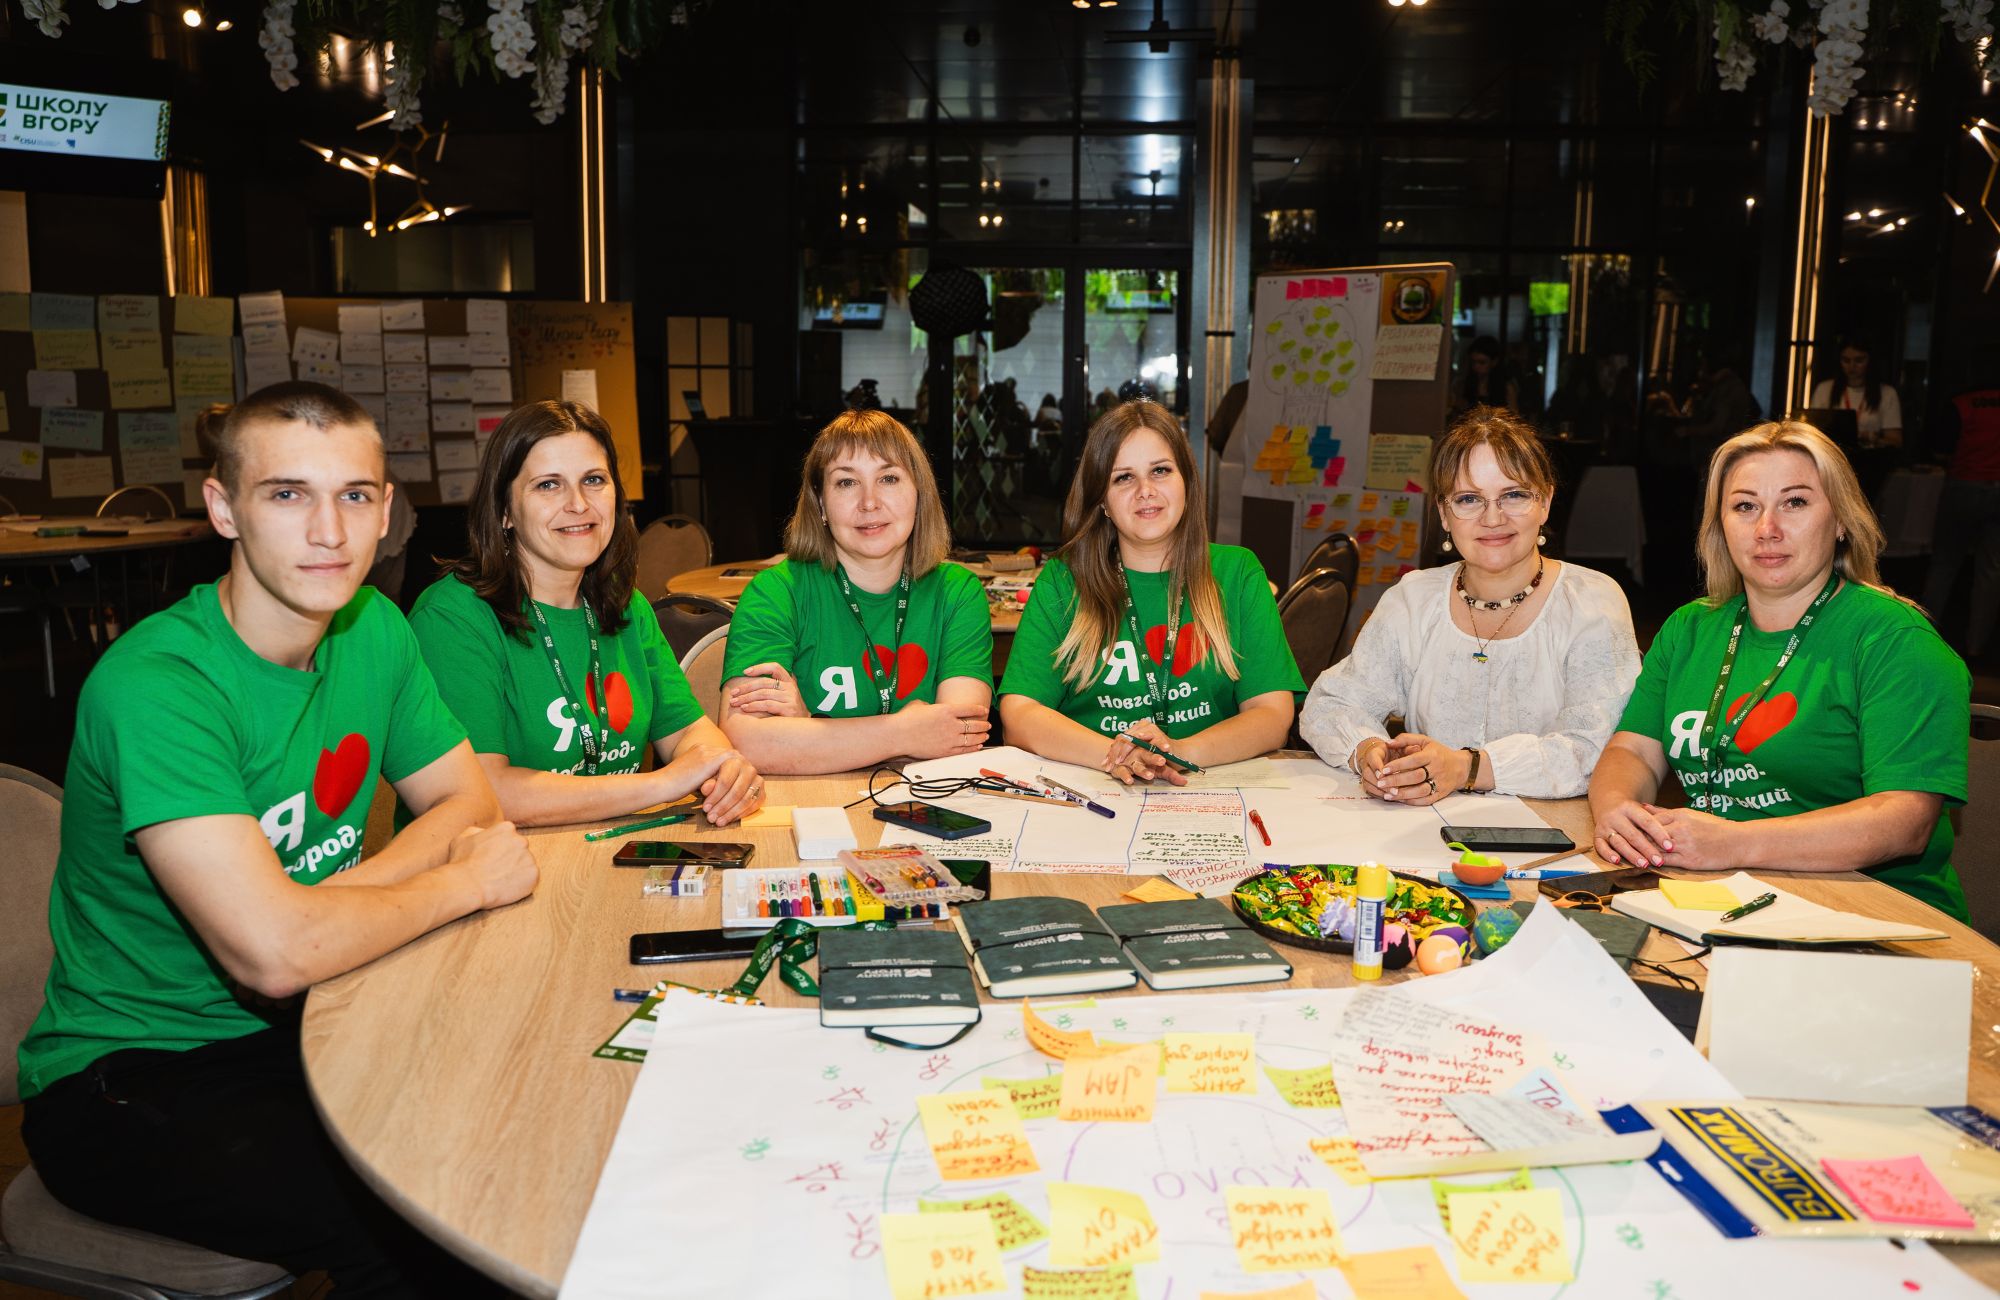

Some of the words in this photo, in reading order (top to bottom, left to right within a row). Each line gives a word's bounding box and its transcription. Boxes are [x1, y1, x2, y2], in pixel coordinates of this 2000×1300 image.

[15, 93, 108, 118] ШКОЛУ
[22, 114, 99, 134] ВГОРУ
[1101, 640, 1140, 686] Я
[816, 665, 858, 712] Я
[1097, 682, 1198, 710] Новгоод-
[1669, 710, 1708, 759] Я
[259, 791, 306, 852] Я
[1085, 1065, 1141, 1103] JAM
[1690, 1109, 1832, 1220] BUROMAX
